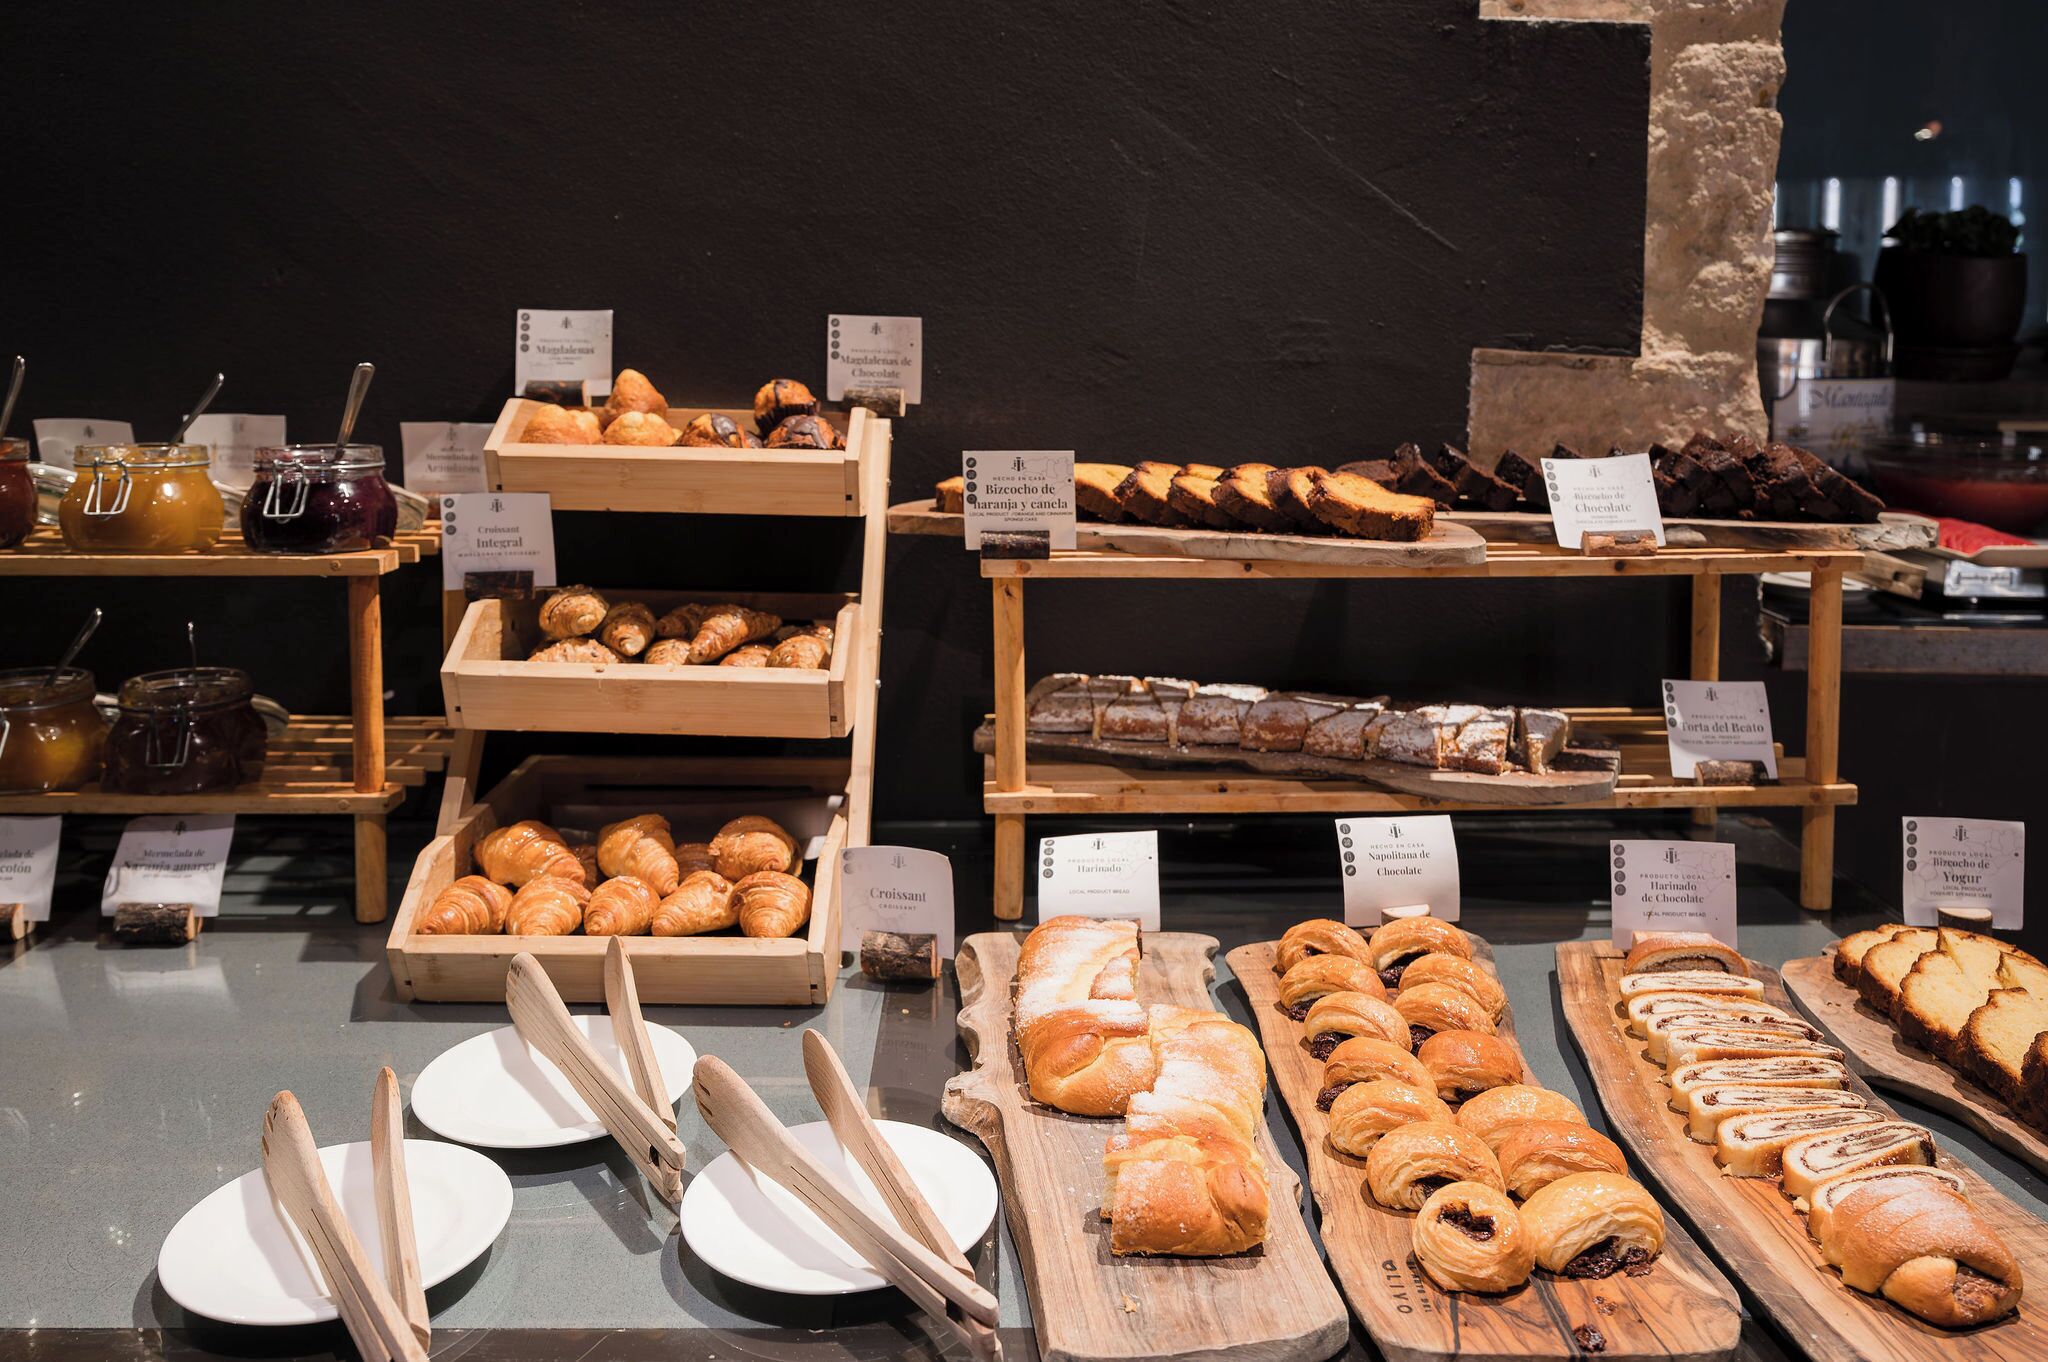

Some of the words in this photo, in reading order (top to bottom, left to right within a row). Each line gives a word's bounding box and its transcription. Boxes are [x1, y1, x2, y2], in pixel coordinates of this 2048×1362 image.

[536, 345, 595, 355] Magdalenas
[840, 355, 899, 366] Magdalenas
[900, 356, 913, 367] de
[851, 368, 901, 379] Chocolate
[985, 483, 1038, 495] Bizcocho
[1041, 483, 1055, 495] de
[1614, 491, 1625, 500] de
[973, 499, 1018, 511] naranja
[1021, 501, 1028, 511] y
[1030, 498, 1068, 510] canela
[1575, 502, 1632, 513] Chocolate
[477, 525, 520, 534] Croissant
[476, 537, 523, 549] Integral
[1681, 721, 1710, 732] Torta
[1712, 721, 1729, 732] del
[1731, 722, 1765, 733] Beato
[24, 849, 35, 858] de
[194, 849, 205, 857] de
[1368, 851, 1418, 862] Napolitana
[1420, 850, 1431, 859] de
[172, 863, 216, 872] amarga
[1077, 864, 1122, 873] Harinado
[1933, 858, 1976, 869] Bizcocho
[1977, 859, 1990, 869] de
[1376, 866, 1423, 877] Chocolate
[1942, 871, 1982, 884] Yogur
[1650, 881, 1697, 891] Harinado
[869, 887, 926, 903] Croissant
[1641, 893, 1653, 903] de
[1655, 893, 1705, 904] Chocolate
[878, 903, 917, 911] CROISSANT
